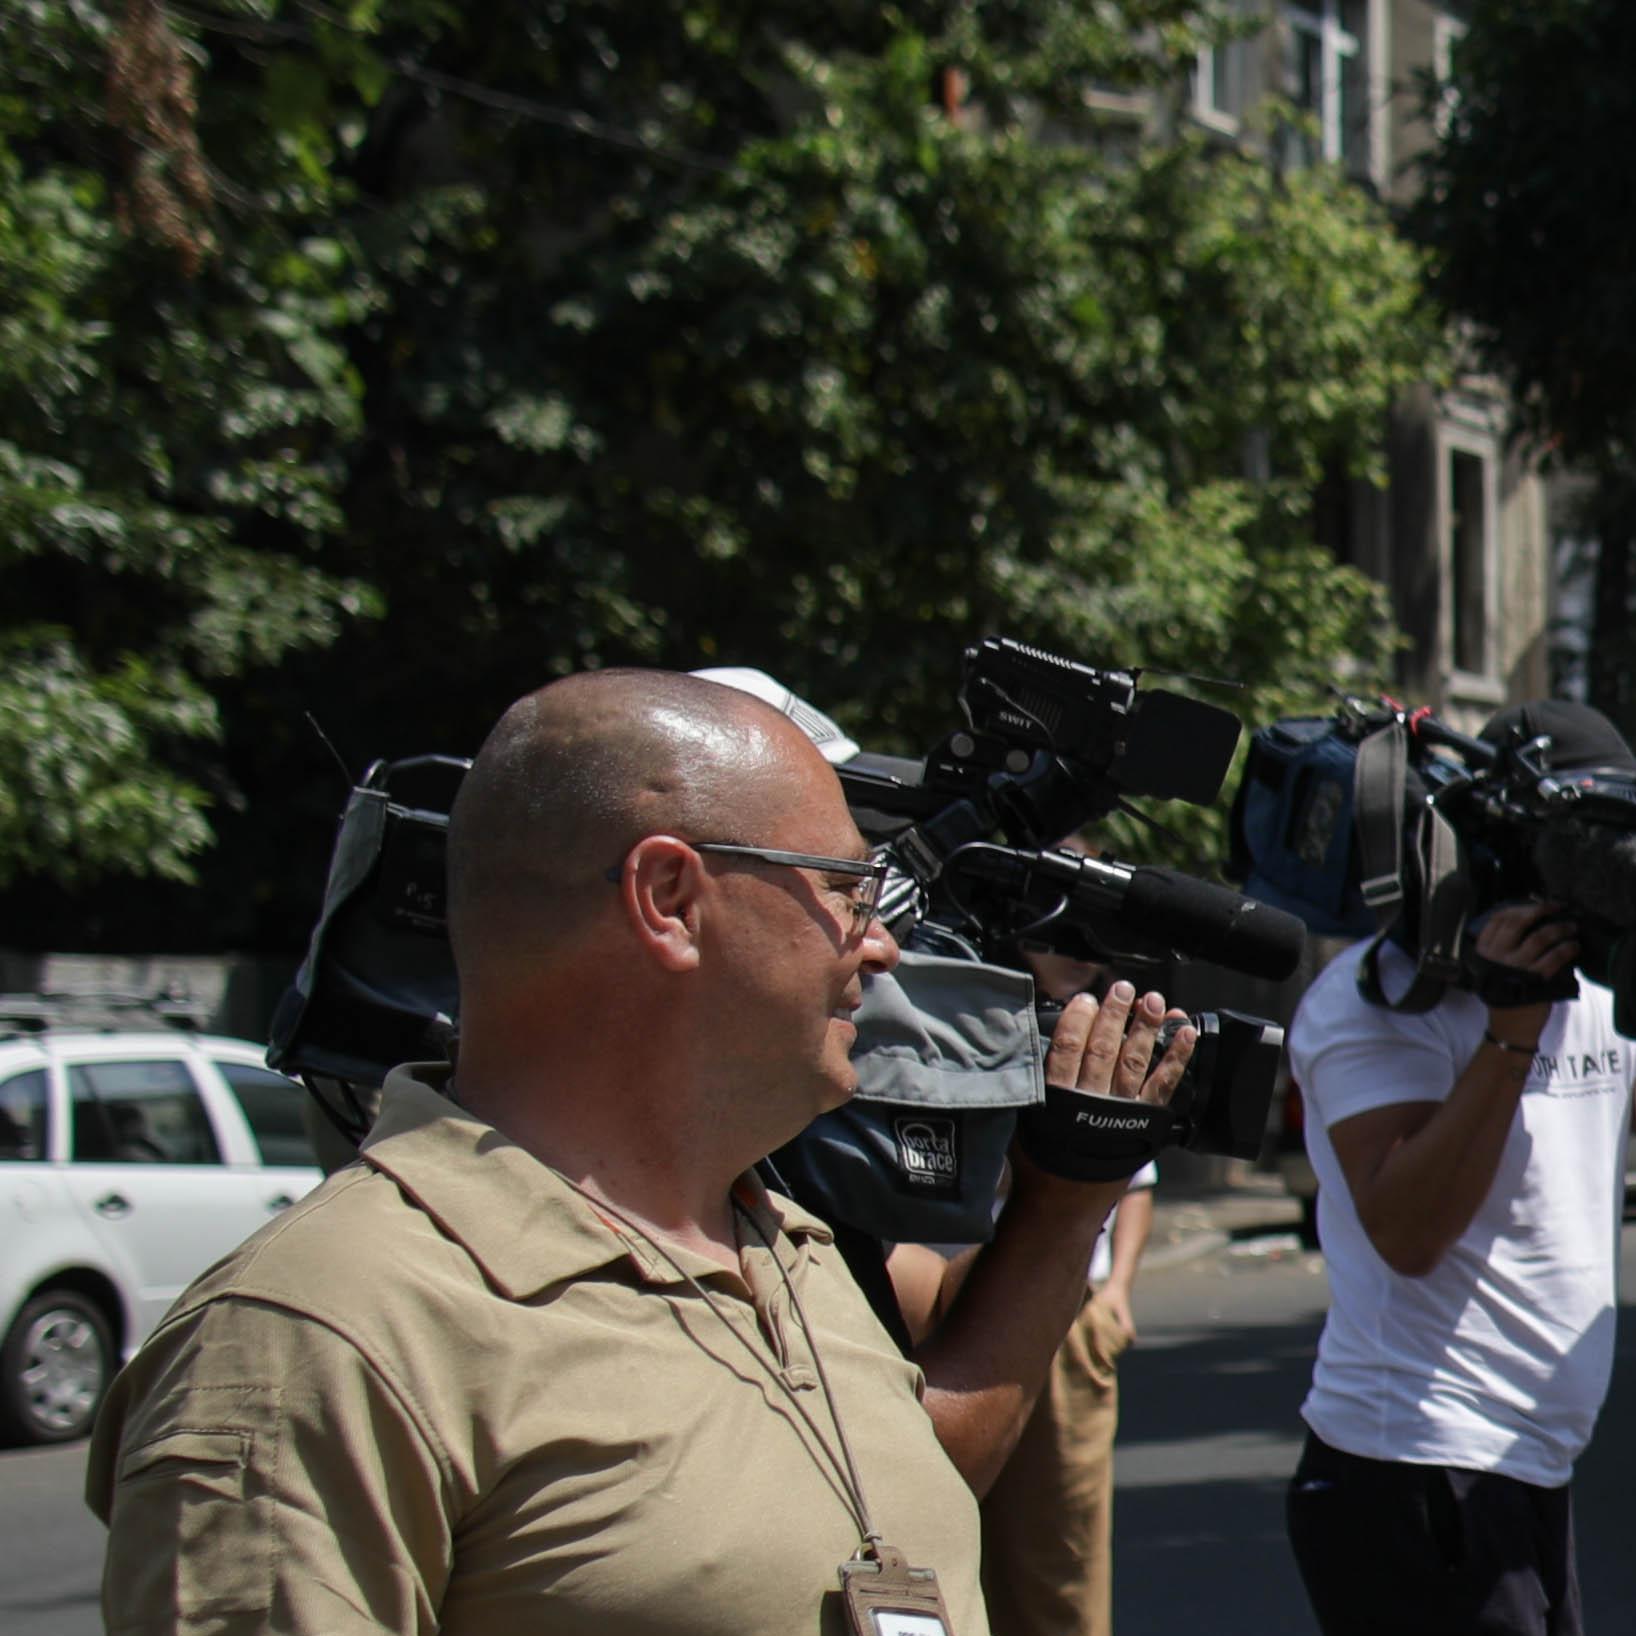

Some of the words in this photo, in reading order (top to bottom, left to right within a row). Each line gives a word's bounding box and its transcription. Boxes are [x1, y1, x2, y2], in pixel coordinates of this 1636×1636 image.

[999, 710, 1034, 730] SWIT
[1076, 1111, 1150, 1131] FUJINON
[907, 1147, 954, 1173] brace
